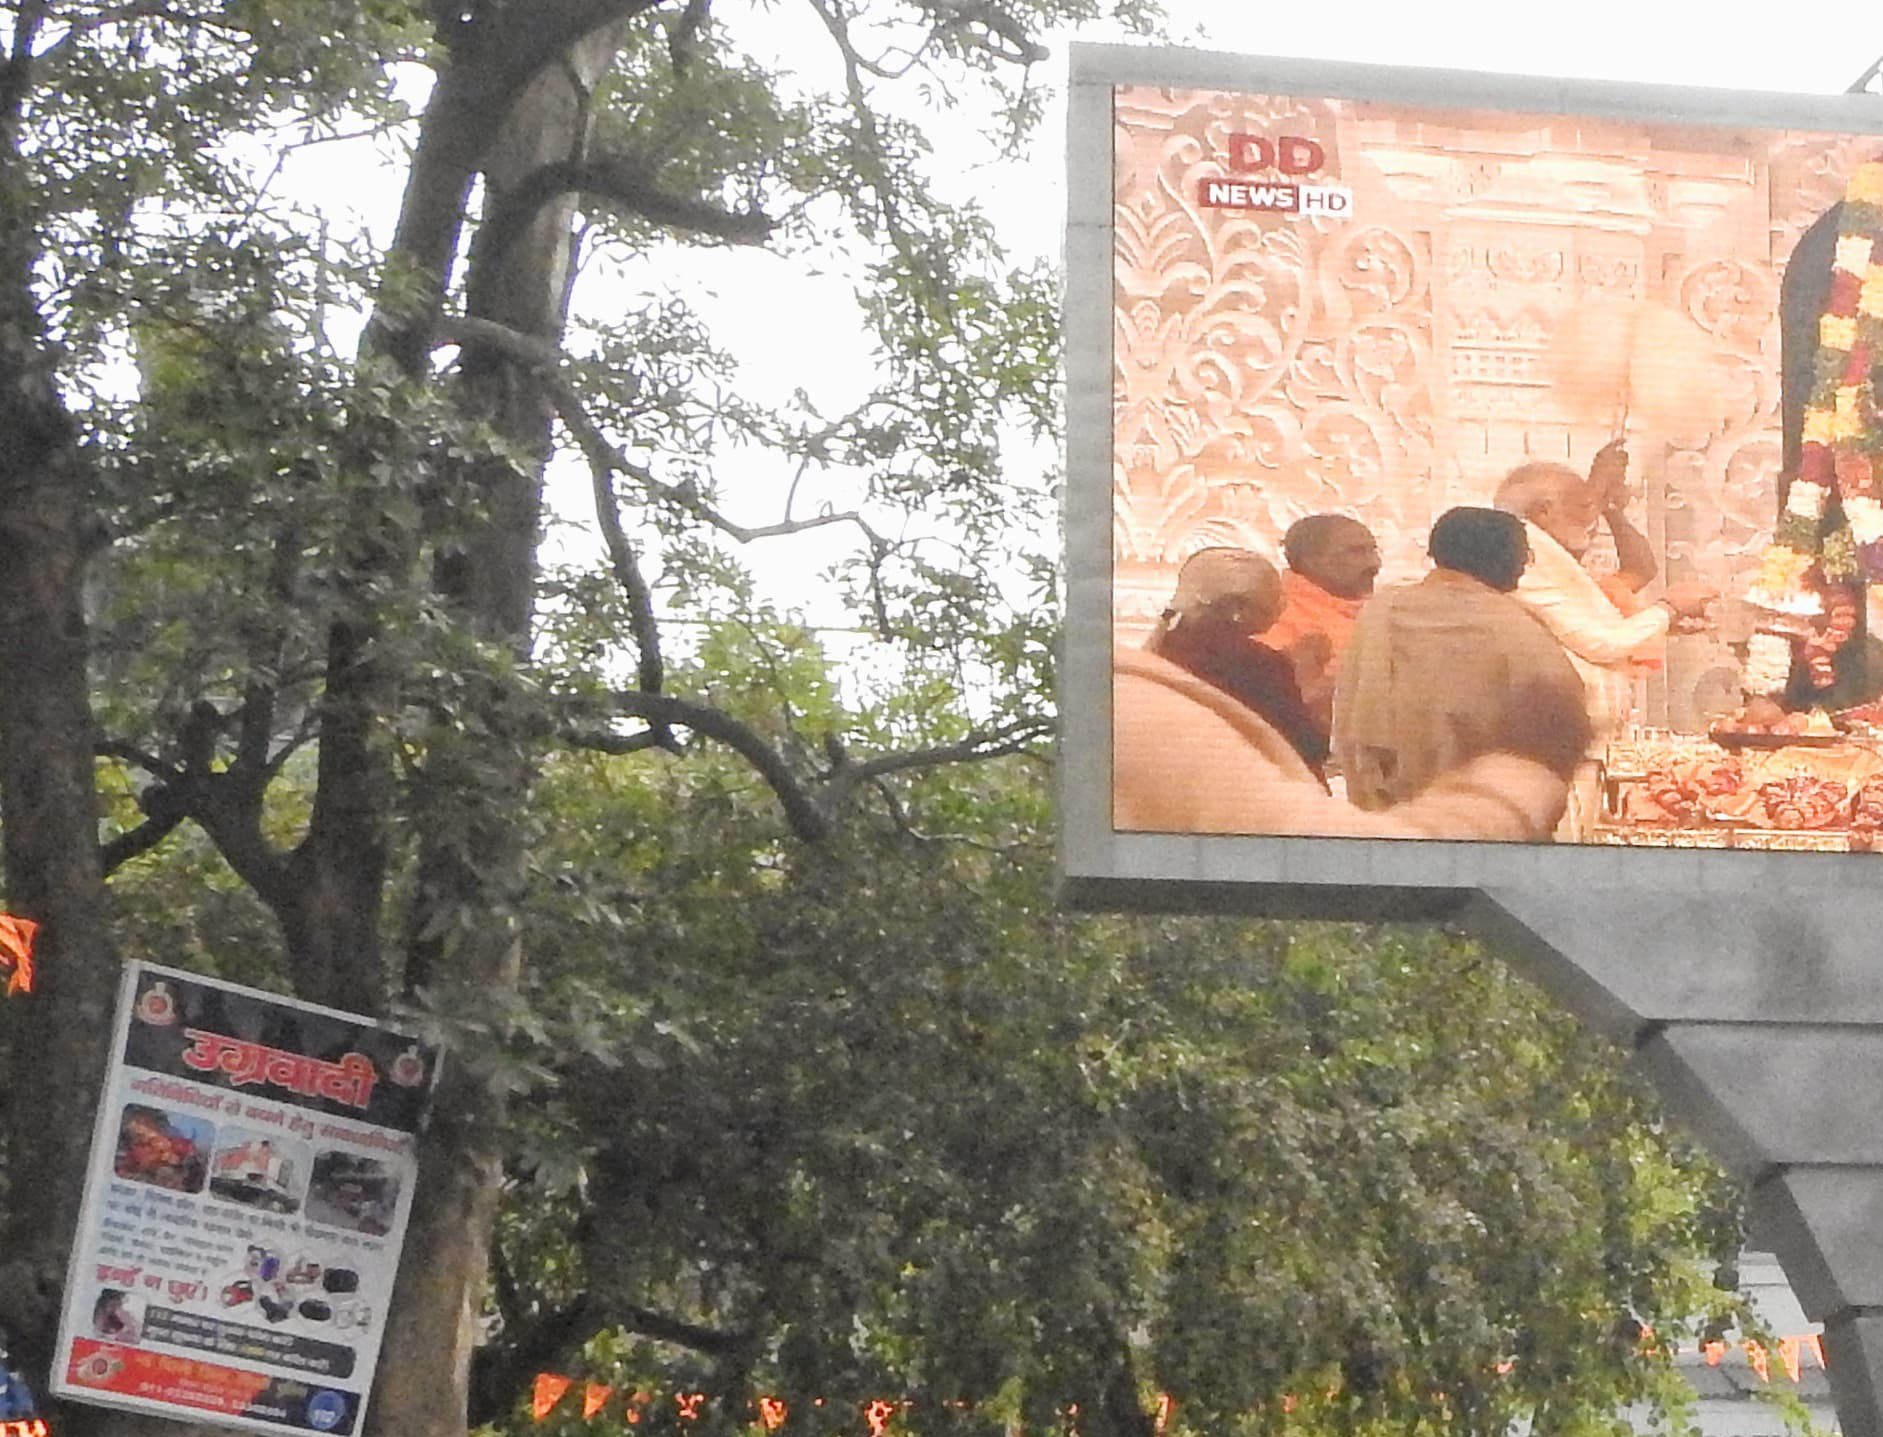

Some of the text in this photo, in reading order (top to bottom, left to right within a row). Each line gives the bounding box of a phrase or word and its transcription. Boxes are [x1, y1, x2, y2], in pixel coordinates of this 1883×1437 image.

[1229, 133, 1324, 174] DD
[1209, 183, 1346, 210] NEWS HD
